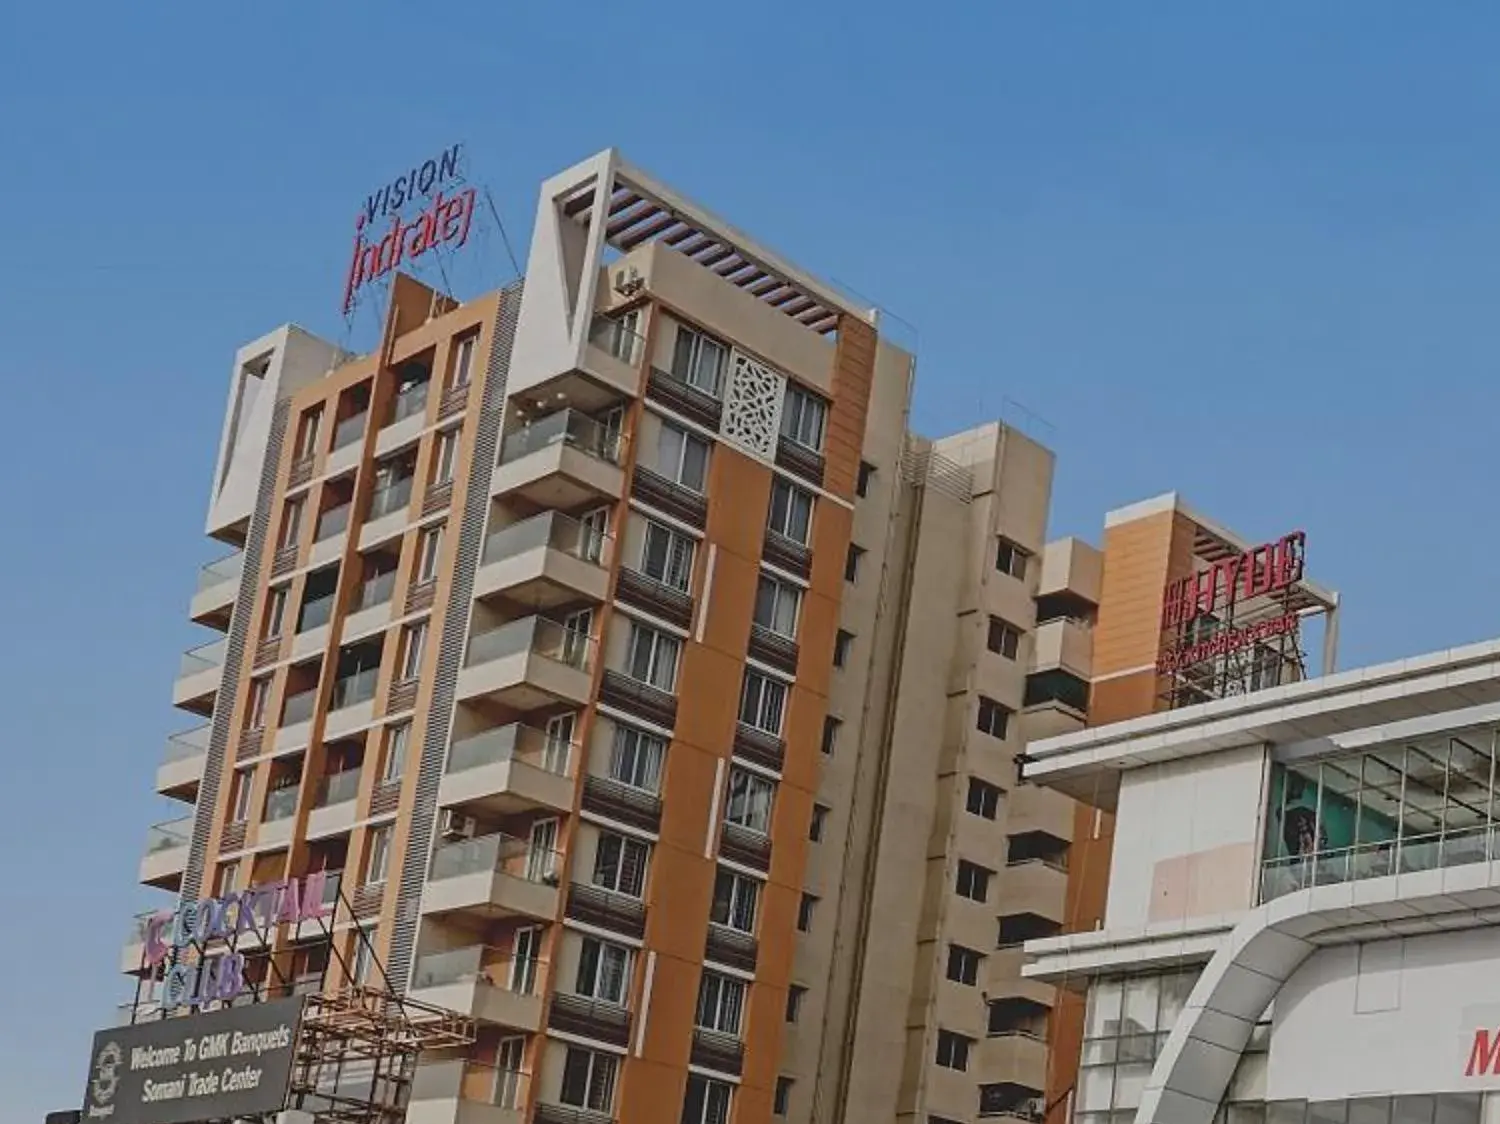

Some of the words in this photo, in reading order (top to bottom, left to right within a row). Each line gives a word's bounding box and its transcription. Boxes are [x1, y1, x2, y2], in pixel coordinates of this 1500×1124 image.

[367, 143, 459, 224] VISION
[131, 1045, 180, 1070] Welcome
[184, 1038, 197, 1062] To
[199, 1031, 231, 1060] GMK
[231, 1024, 291, 1056] Banquets
[142, 1073, 185, 1102] Somani
[188, 1071, 219, 1096] Trade
[221, 1065, 262, 1091] Center
